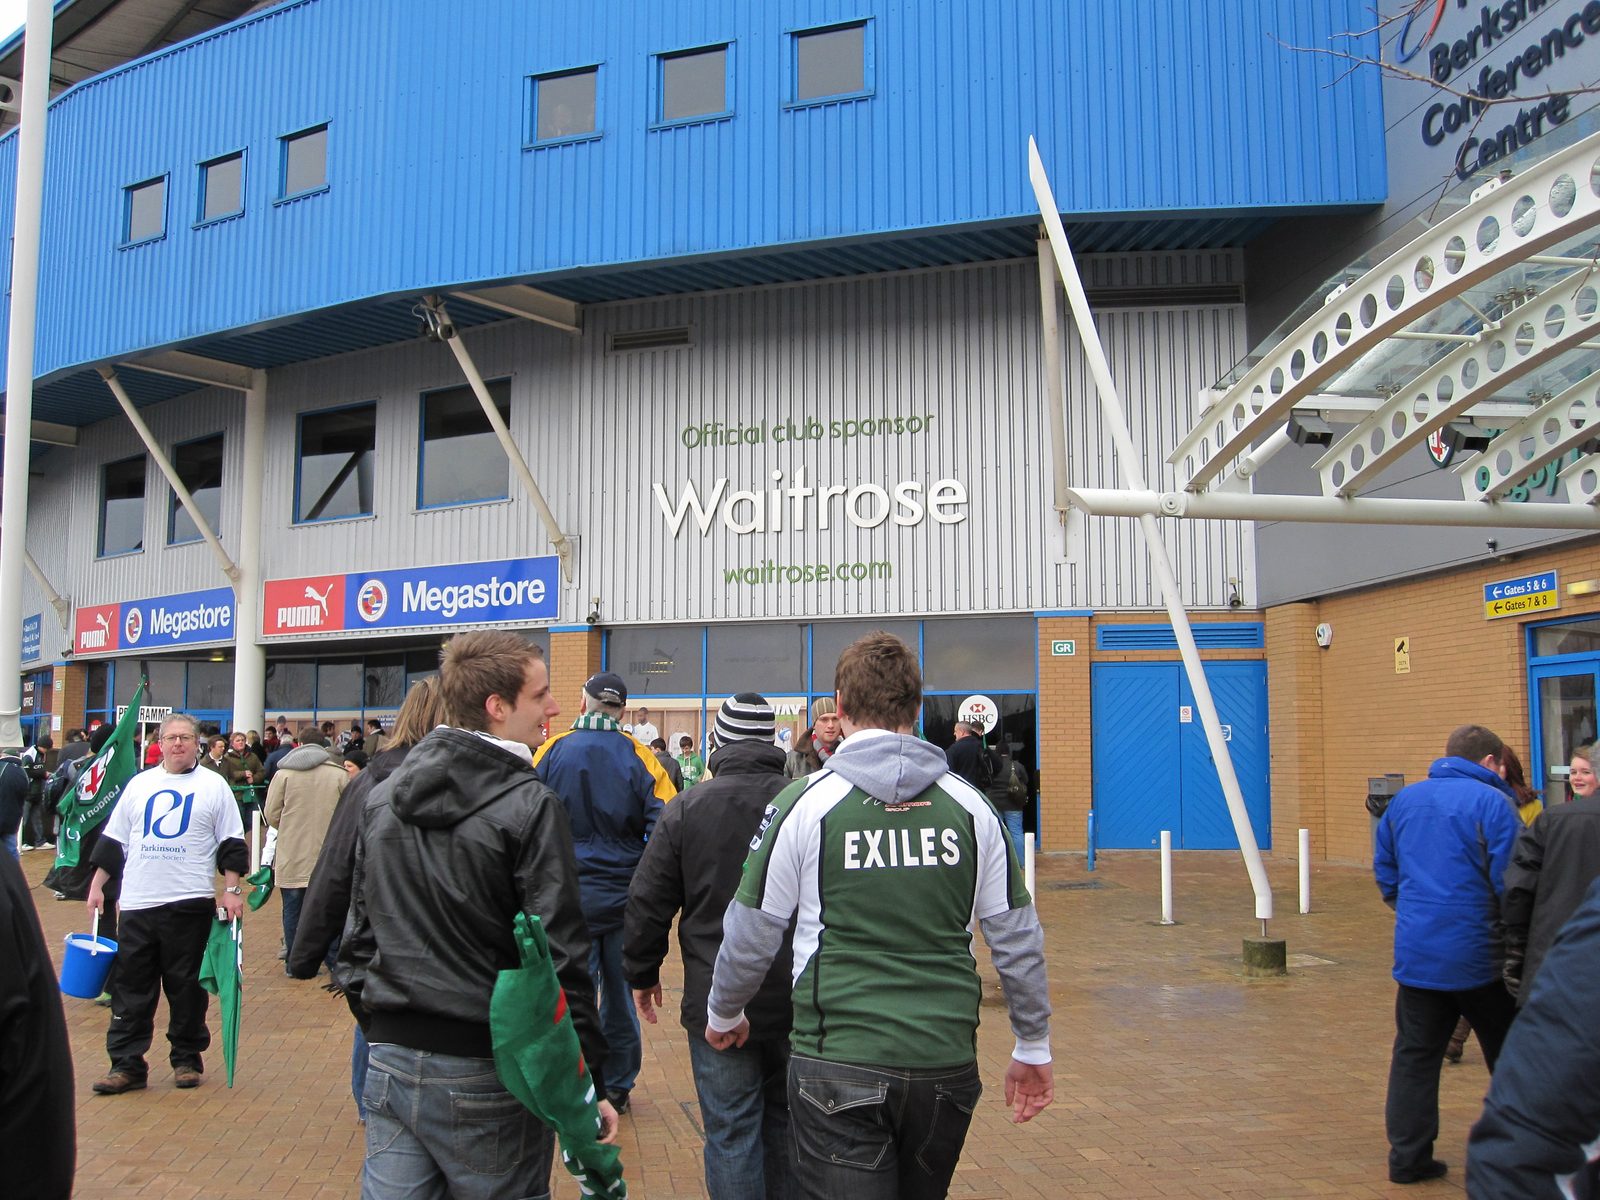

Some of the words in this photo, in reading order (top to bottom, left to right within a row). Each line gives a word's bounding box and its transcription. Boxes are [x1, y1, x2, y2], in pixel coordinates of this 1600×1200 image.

[1420, 0, 1600, 147] Conference
[1455, 92, 1571, 182] Centre
[681, 417, 766, 449] Official
[771, 415, 825, 443] club
[830, 414, 936, 446] sponsor
[651, 464, 969, 541] Waitrose
[723, 558, 893, 586] waitrose.com
[402, 575, 546, 618] Megastore
[1504, 585, 1525, 596] Gates
[1526, 581, 1532, 592] 5
[1533, 579, 1540, 591] &
[1541, 578, 1547, 589] 6
[1505, 600, 1526, 611] Gates
[1527, 597, 1532, 608] 7
[1534, 595, 1541, 606] &
[1542, 594, 1548, 605] 8
[149, 602, 232, 639] Megastore
[277, 604, 322, 628] PUMA
[80, 629, 106, 649] PUMA
[1054, 643, 1072, 653] GR
[118, 707, 171, 721] PRAMM
[962, 714, 994, 725] HSBC
[141, 843, 187, 854] Parkinson's
[843, 827, 961, 870] EXILES
